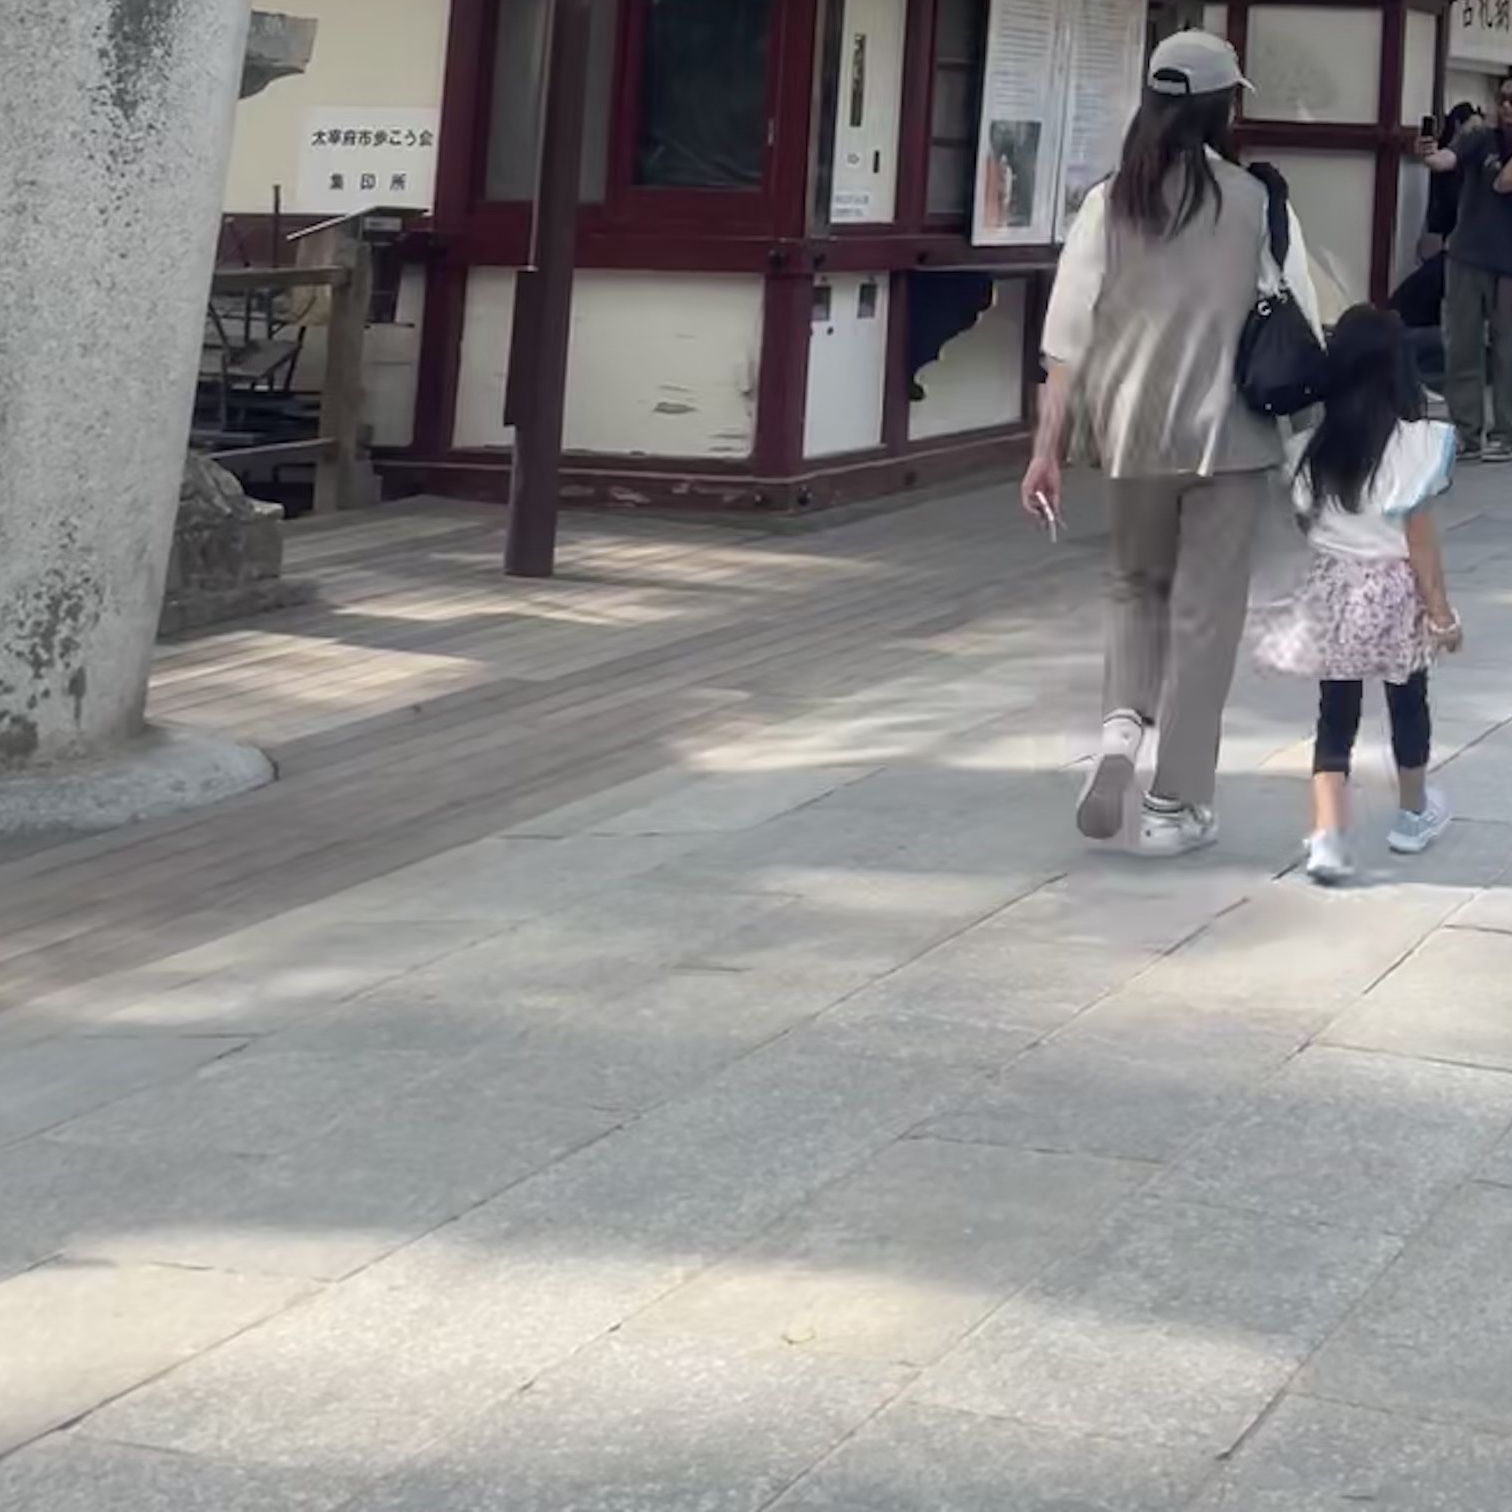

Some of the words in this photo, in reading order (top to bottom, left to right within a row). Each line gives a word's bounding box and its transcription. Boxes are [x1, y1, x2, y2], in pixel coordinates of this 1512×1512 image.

[311, 129, 433, 147] 太宰府市歩こう会
